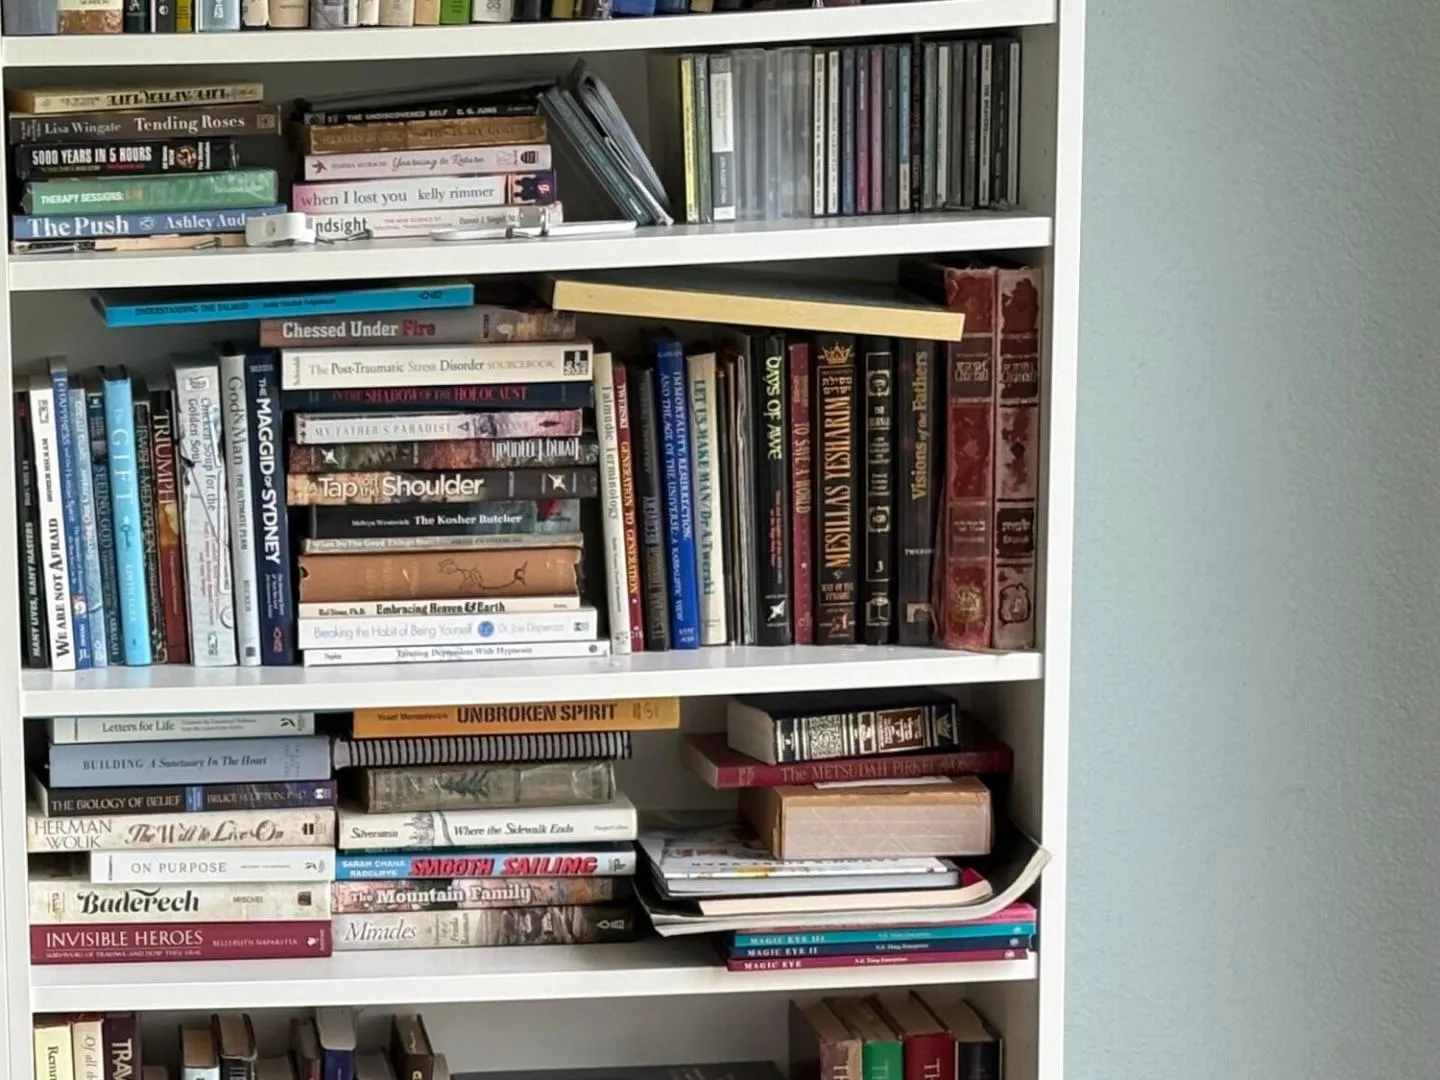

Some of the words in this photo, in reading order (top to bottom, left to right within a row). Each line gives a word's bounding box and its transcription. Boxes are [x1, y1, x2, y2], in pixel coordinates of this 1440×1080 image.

[44, 123, 69, 134] Lisa
[72, 122, 122, 135] Wingate
[134, 117, 199, 134] Tending
[202, 115, 245, 129] Roses
[32, 150, 58, 165] 5000
[61, 149, 91, 164] YEARS
[95, 149, 106, 163] IN
[109, 148, 116, 162] 5
[119, 147, 152, 162] HOURS
[301, 194, 339, 208] when
[343, 191, 350, 205] I
[353, 190, 378, 205] lost
[382, 190, 408, 206] you
[417, 187, 445, 202] kelly
[449, 186, 495, 199] rimmer
[27, 218, 70, 237] The
[75, 215, 129, 235] Push
[282, 322, 346, 338] Chessed
[351, 321, 399, 337] Under
[402, 321, 436, 336] Fire
[309, 364, 328, 375] The
[331, 361, 404, 375] Post-Traumatic
[408, 361, 436, 373] Stress
[439, 360, 484, 371] Disorder
[257, 379, 269, 396] THE
[256, 397, 276, 475] MAGGID
[825, 394, 851, 480] YESHARIM
[152, 409, 176, 507] TRIUMPH
[264, 475, 273, 484] OF
[318, 478, 357, 498] Tap
[382, 475, 484, 496] Shoulder
[260, 488, 281, 565] SYDNEY
[414, 516, 434, 525] The
[437, 515, 476, 525] Kosher
[479, 514, 522, 525] Butcher
[825, 486, 852, 568] MESILLAS
[47, 518, 65, 571] AFRAID
[51, 573, 66, 599] NOT
[54, 600, 69, 628] ARE
[457, 705, 556, 724] UNBROKEN
[560, 703, 618, 721] SPIRIT
[35, 820, 112, 835] HERMAN
[47, 835, 101, 849] WOUK
[131, 863, 152, 873] ON
[159, 862, 228, 873] PURPOSE
[409, 858, 494, 876] SMOOTH
[501, 857, 598, 875] SAILING
[77, 889, 199, 914] Baderech
[351, 889, 373, 903] The
[376, 887, 467, 904] Mountain
[470, 885, 532, 901] Family
[47, 932, 127, 947] INVISIBLE
[135, 930, 204, 945] HEROES
[345, 920, 416, 942] Miracles
[744, 962, 779, 970] MAGIC
